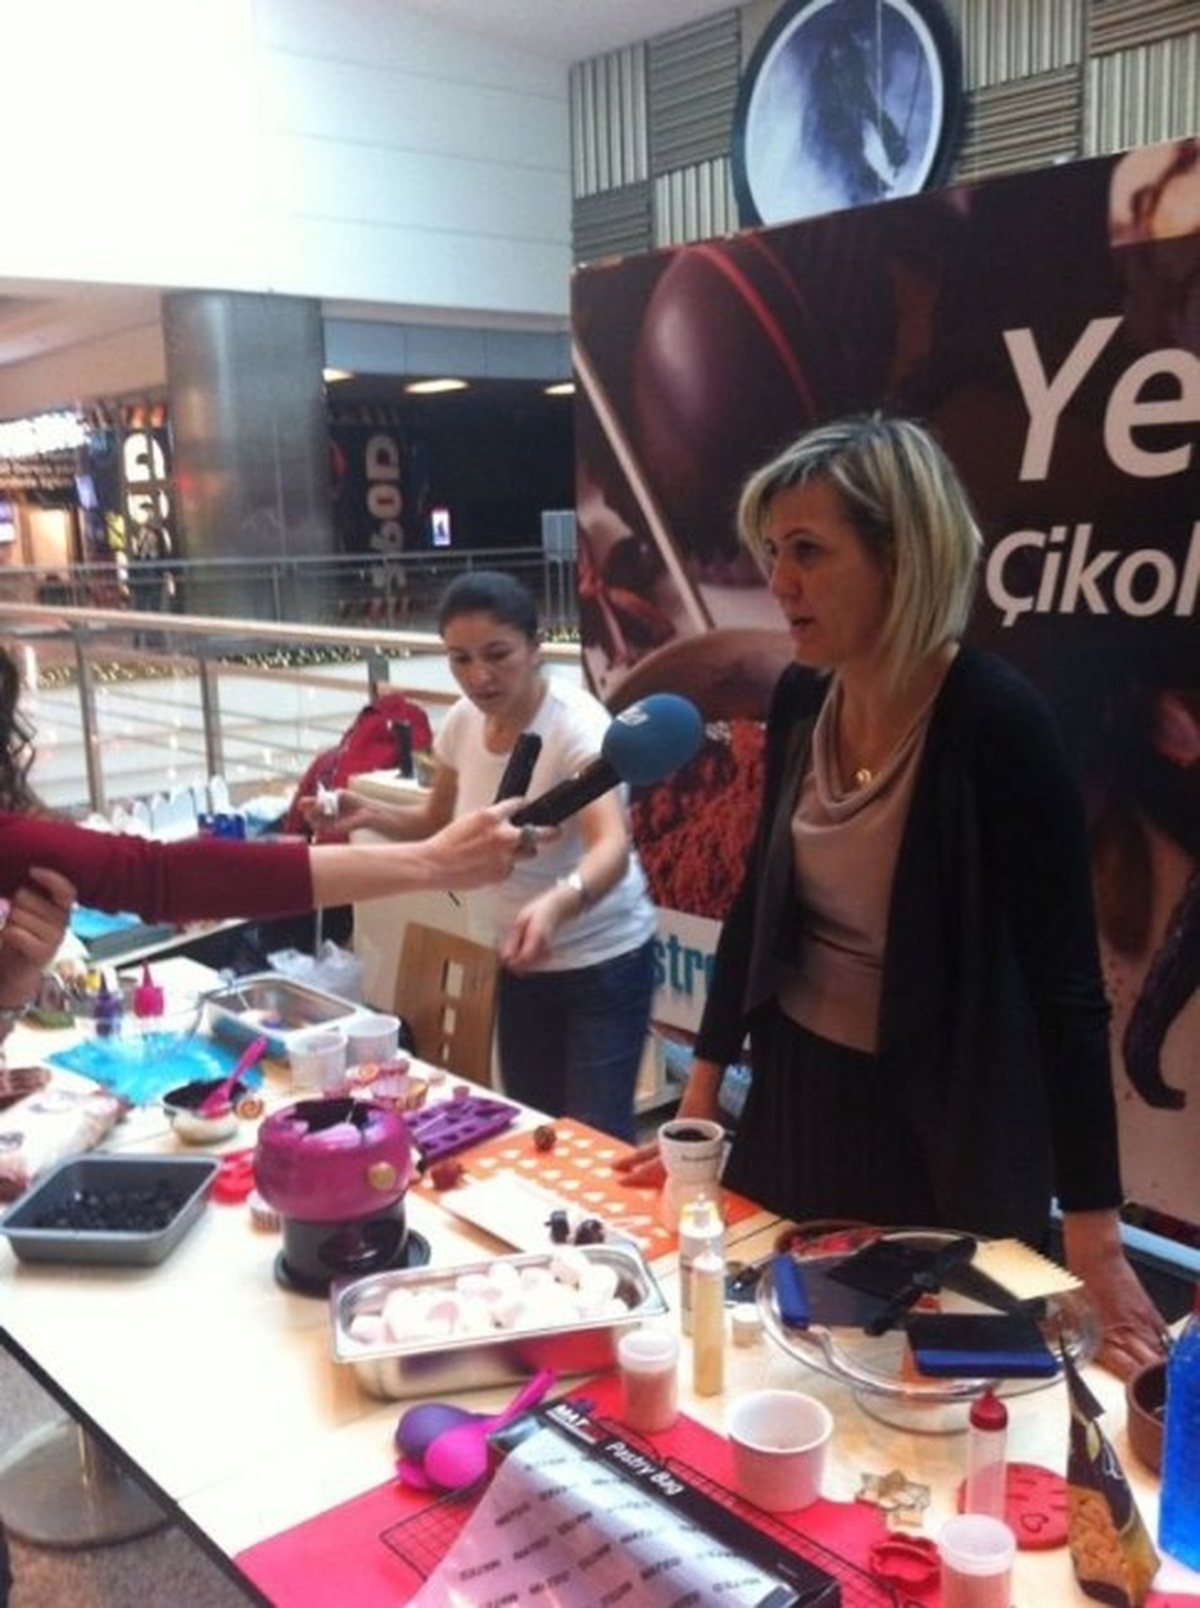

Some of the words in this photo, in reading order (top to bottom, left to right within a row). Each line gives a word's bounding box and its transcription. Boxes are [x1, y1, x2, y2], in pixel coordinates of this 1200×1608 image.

[1003, 315, 1200, 482] Ye
[985, 522, 1200, 628] Çikol
[605, 1441, 652, 1476] Pastry
[650, 1472, 684, 1495] Bag
